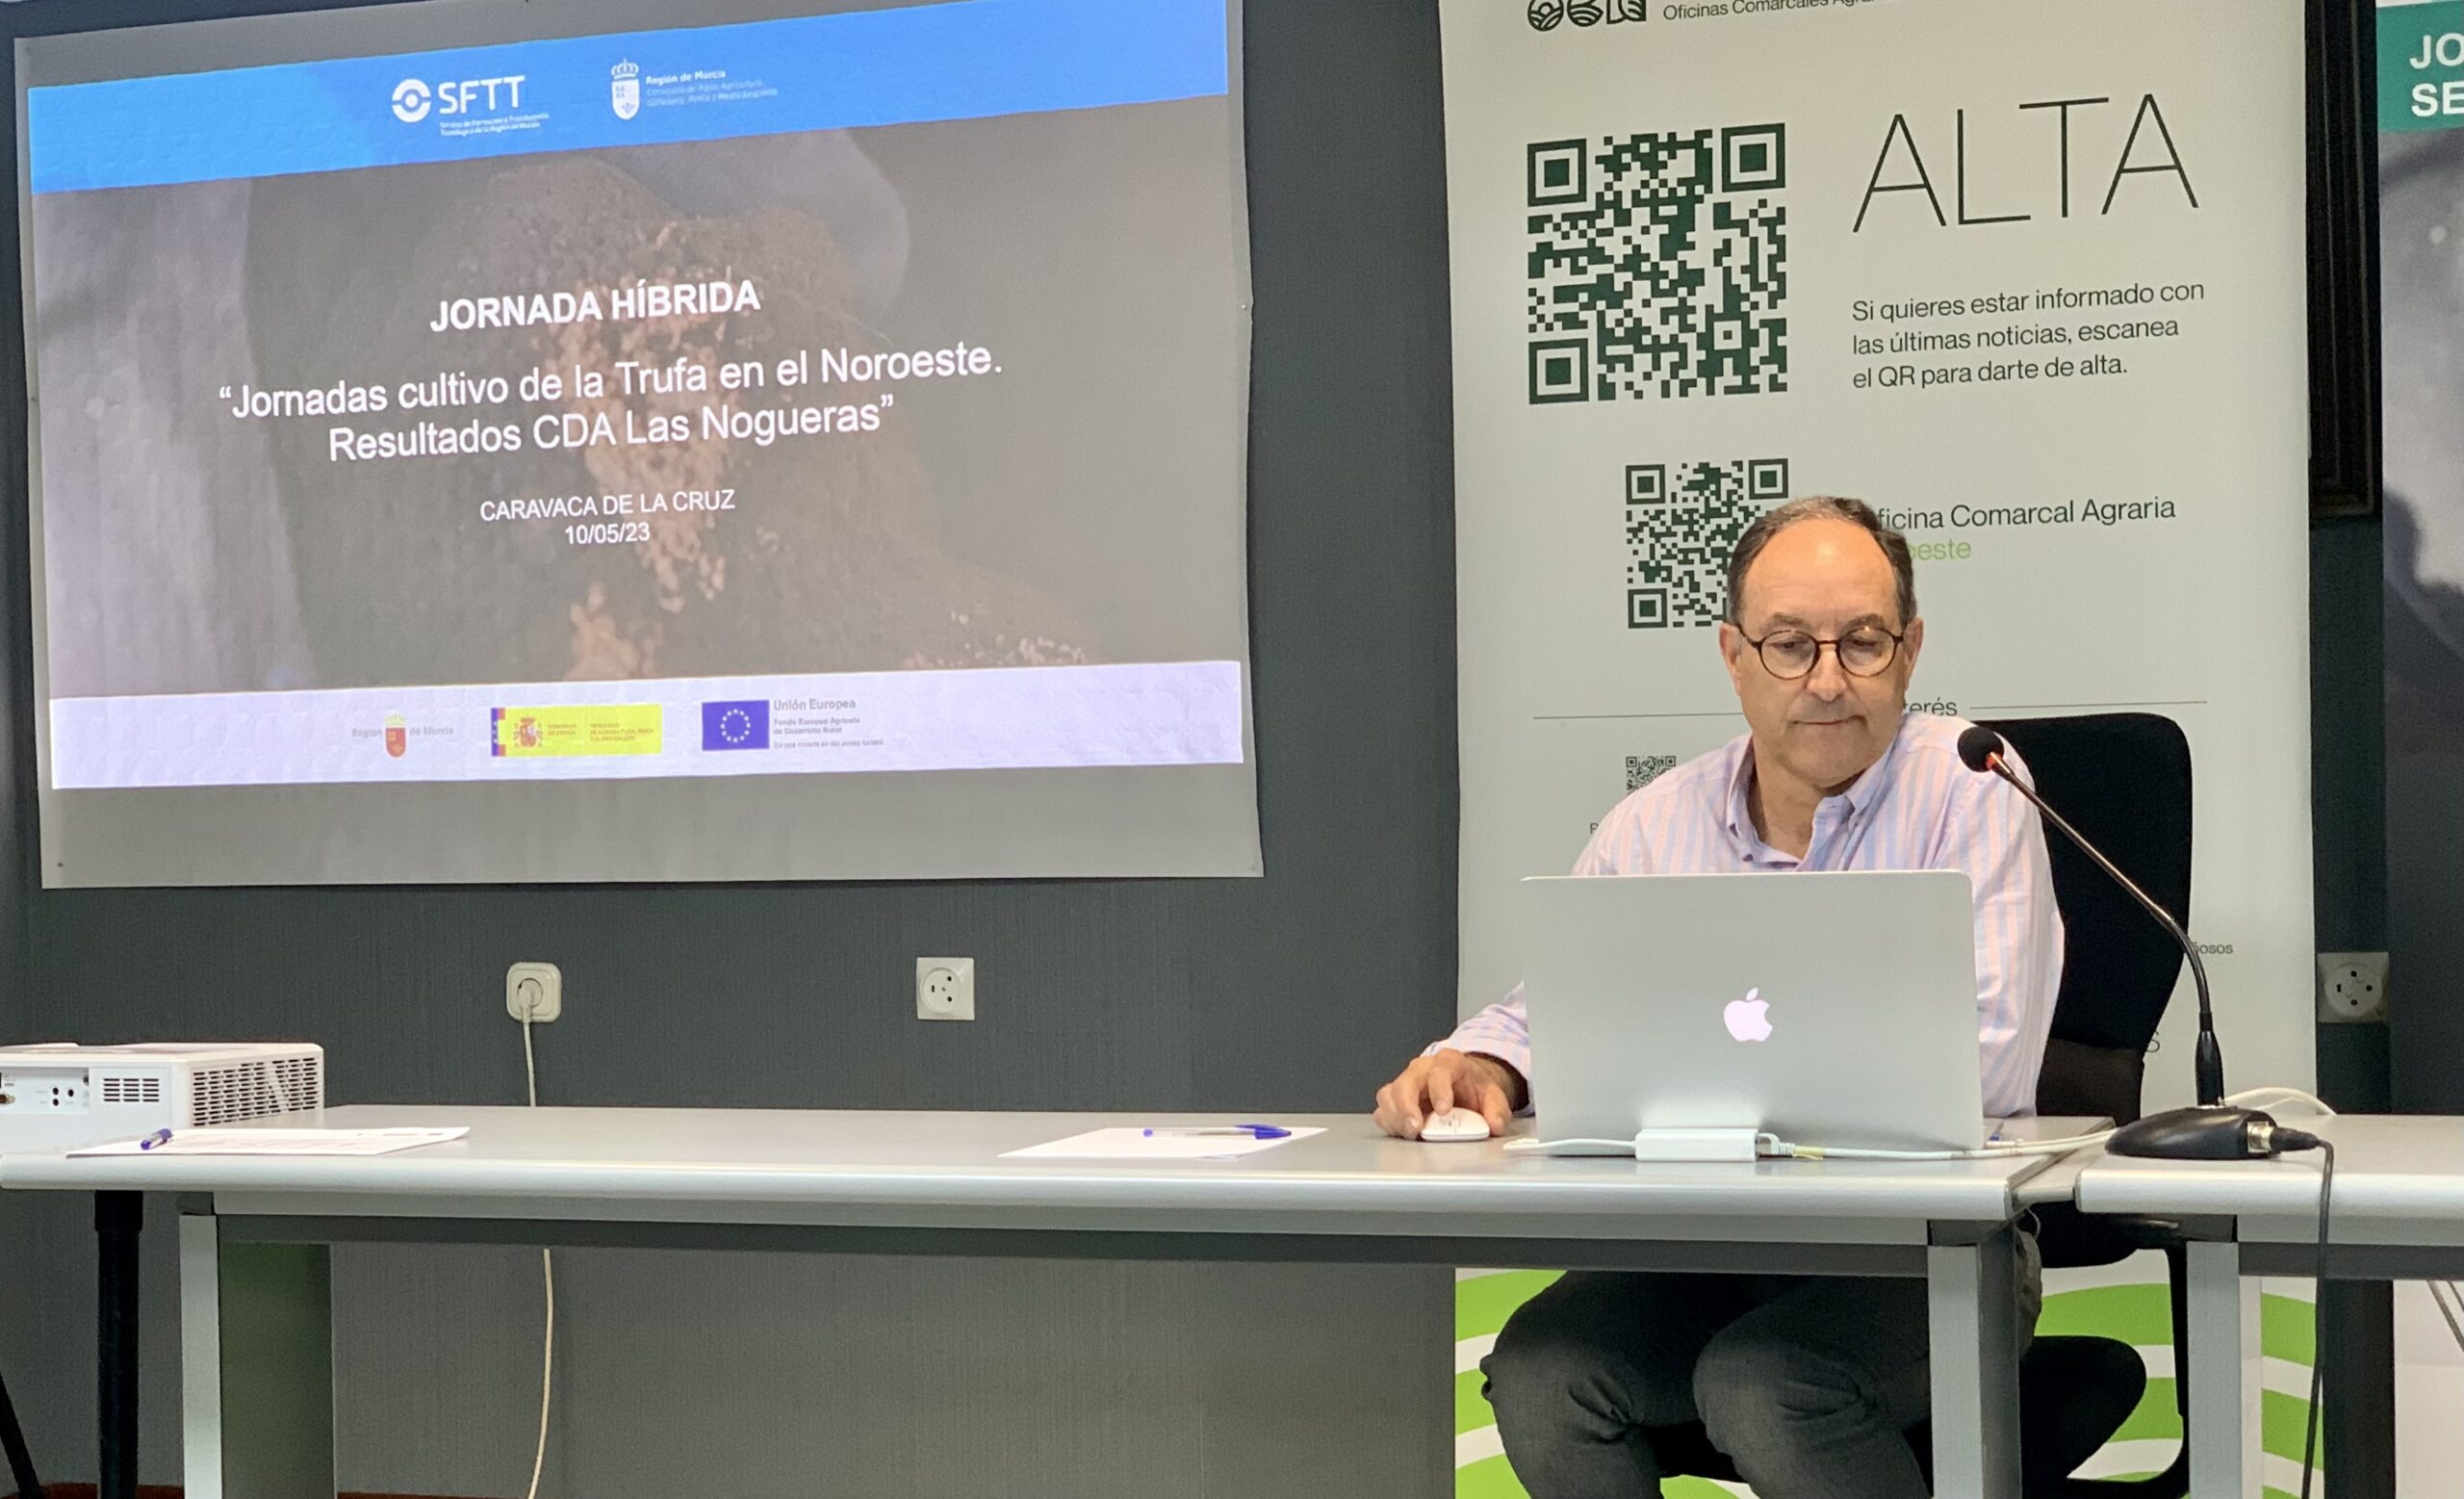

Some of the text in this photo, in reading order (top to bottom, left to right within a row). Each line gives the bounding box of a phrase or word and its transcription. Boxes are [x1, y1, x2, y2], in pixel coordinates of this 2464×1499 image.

[1663, 3, 1729, 20] Oficinas
[438, 75, 526, 115] SFTT
[1852, 93, 2199, 233] ALTA
[430, 278, 761, 332] JORNADA HÍBRIDA
[1853, 283, 2205, 323] Si quieres estar informado con
[1853, 318, 2179, 355] las últimas noticias, escanea
[398, 372, 508, 409] cultivo
[520, 367, 563, 401] de
[576, 364, 604, 399] la
[615, 356, 707, 396] Trufa
[720, 360, 764, 392] en
[777, 349, 808, 386] el
[821, 341, 1003, 383] Noroeste.
[1853, 353, 2128, 389] el QR para darte de alta.
[329, 419, 522, 462] Resultados
[533, 412, 617, 450] CDA
[627, 410, 690, 445] Las
[479, 489, 736, 522] CARAVACA DE LA CRUZ
[1877, 496, 2176, 530] ficina Comarcal Agraria
[564, 522, 651, 545] 10/05/23
[1908, 538, 1972, 561] oeste
[773, 698, 857, 711] Unión Europea
[1905, 696, 1958, 716] erés
